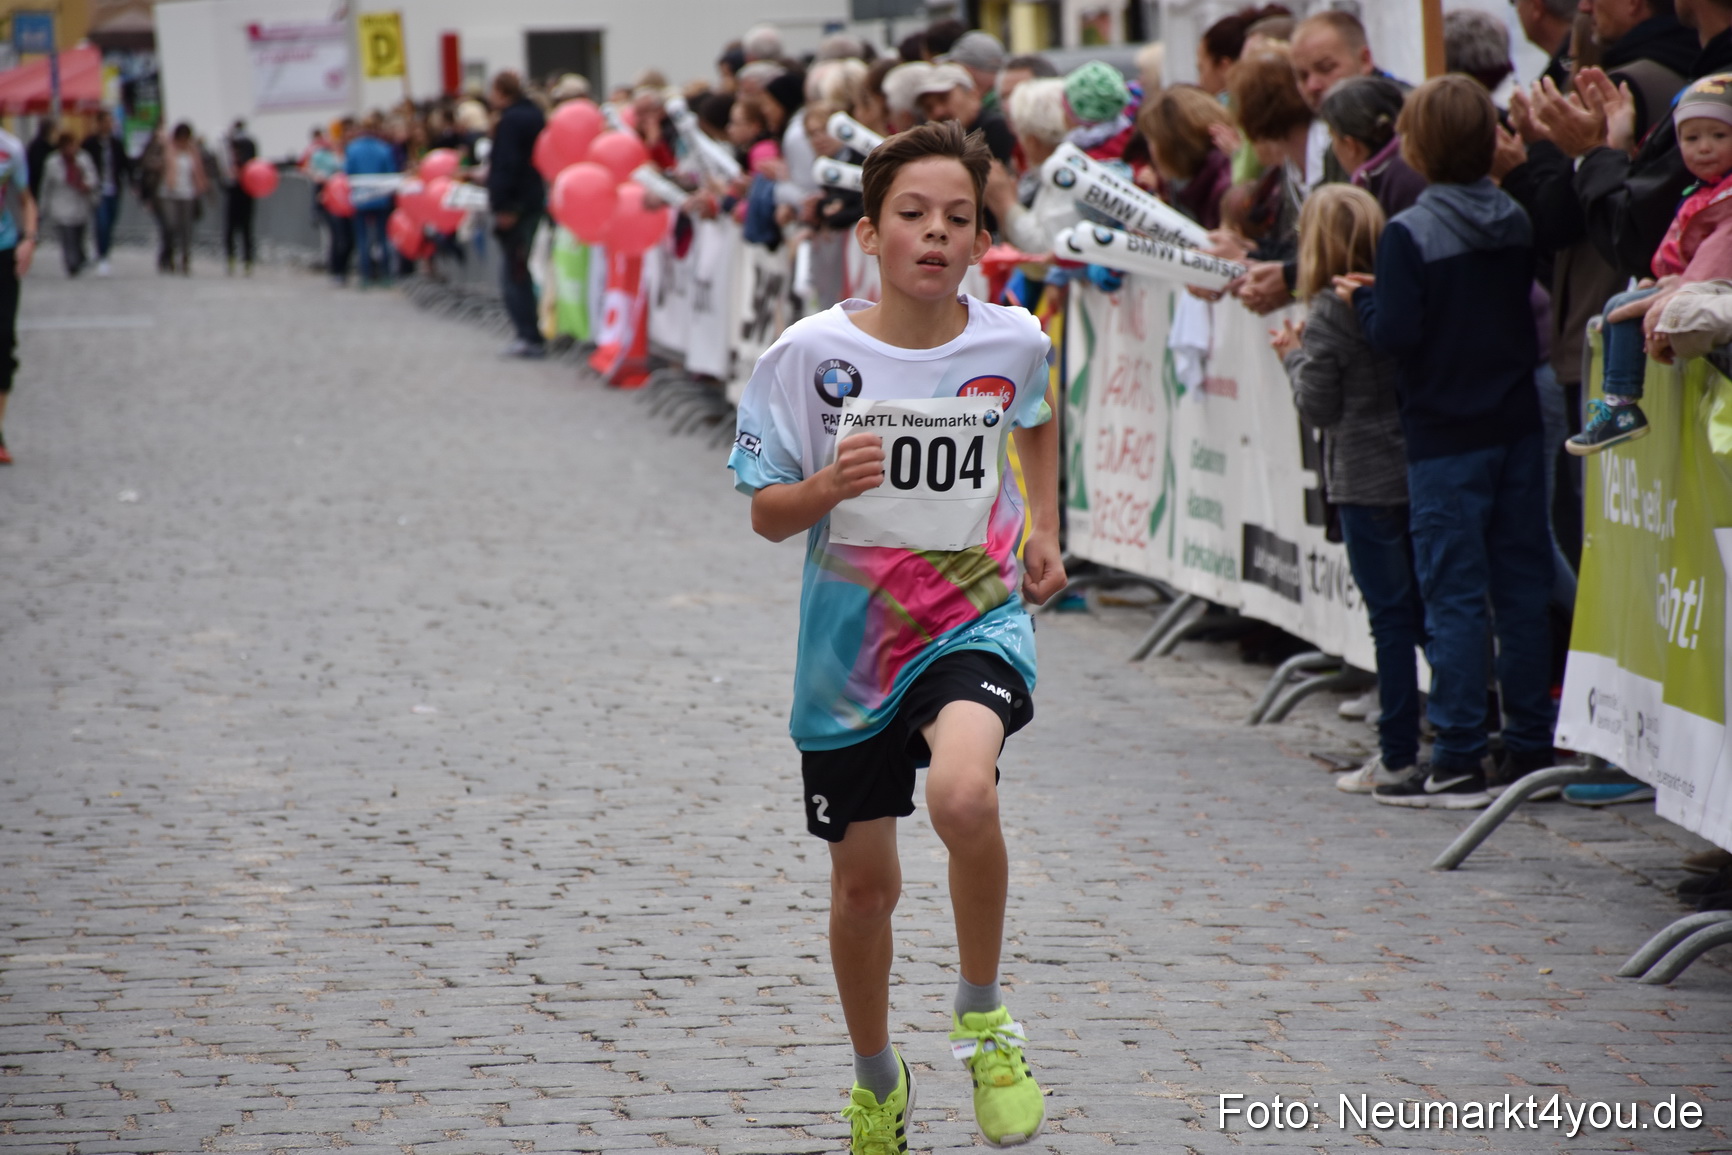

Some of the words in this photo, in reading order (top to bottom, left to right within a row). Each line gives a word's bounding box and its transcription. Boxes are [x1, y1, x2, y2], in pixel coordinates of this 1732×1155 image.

[1085, 184, 1136, 220] BMW
[1127, 235, 1174, 262] BMW
[817, 360, 857, 377] BMW
[843, 413, 898, 428] PARTL
[902, 413, 978, 428] Neumarkt
[1616, 413, 1635, 428] 24
[876, 435, 985, 492] 004
[811, 794, 831, 825] 2
